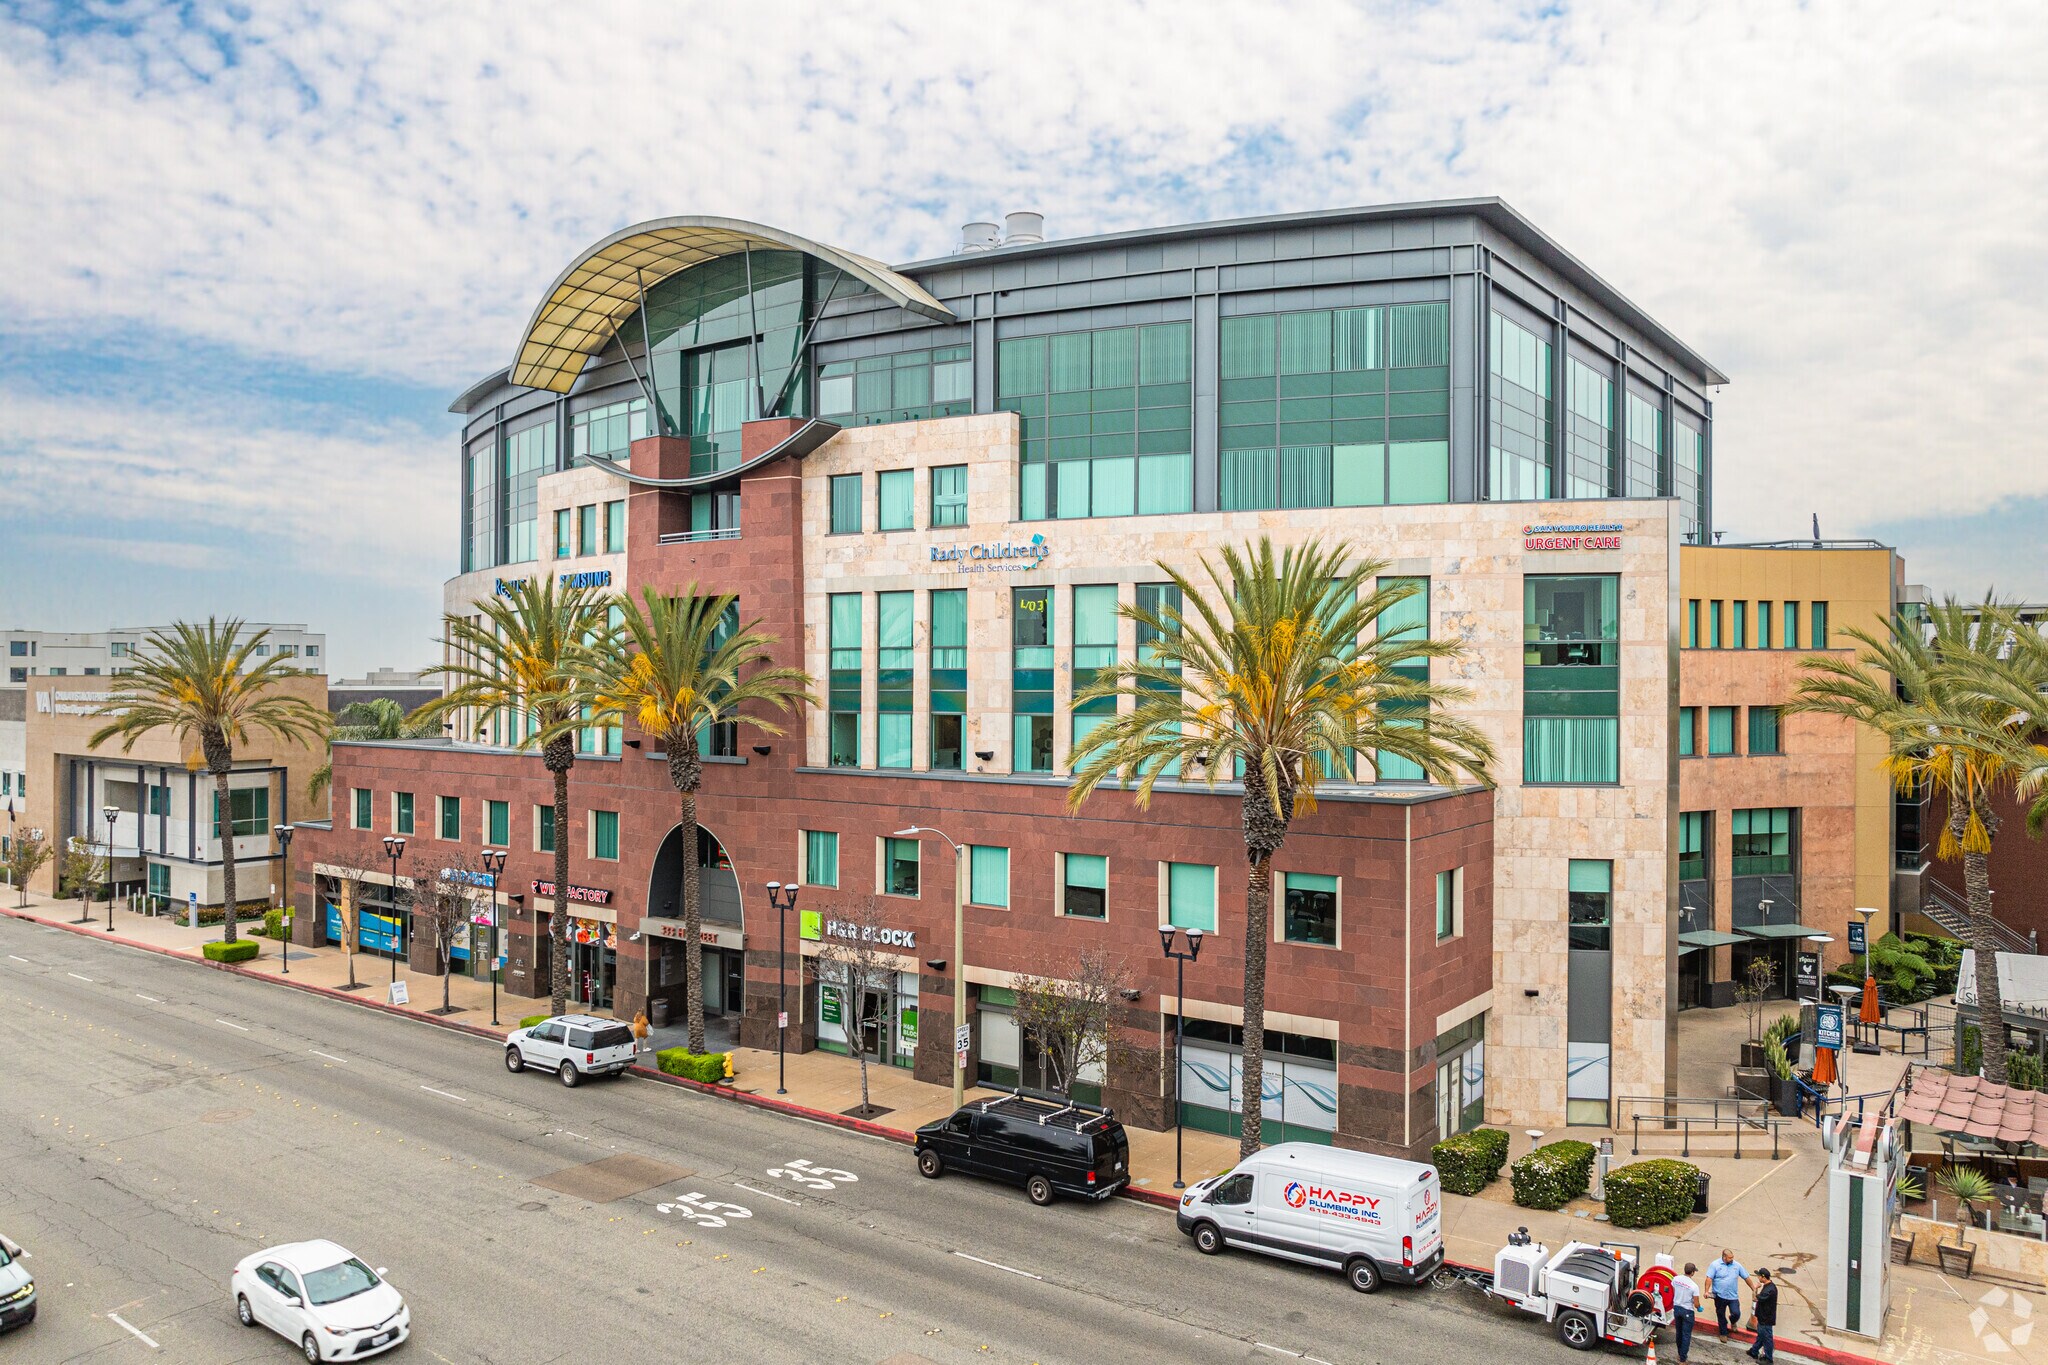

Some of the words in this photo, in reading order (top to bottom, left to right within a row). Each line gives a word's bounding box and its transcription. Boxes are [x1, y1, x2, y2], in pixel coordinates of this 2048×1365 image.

[1588, 523, 1623, 532] HEALTH
[1525, 538, 1581, 550] URGENT
[1584, 537, 1621, 549] CARE
[930, 544, 968, 563] Rady
[958, 564, 985, 573] Health
[987, 561, 1021, 573] Services
[827, 920, 857, 940] H&R
[862, 925, 915, 949] BLOCK
[2016, 1003, 2026, 1015] &
[903, 1029, 917, 1038] BLOC
[957, 1038, 969, 1050] 35
[767, 1159, 859, 1190] 35
[1309, 1186, 1381, 1210] HAPPY
[656, 1192, 753, 1227] 35
[1309, 1199, 1359, 1215] PLUMBING
[1361, 1209, 1382, 1220] INC.
[1309, 1206, 1382, 1226] 619-433-4943
[1415, 1200, 1438, 1224] HAPPY
